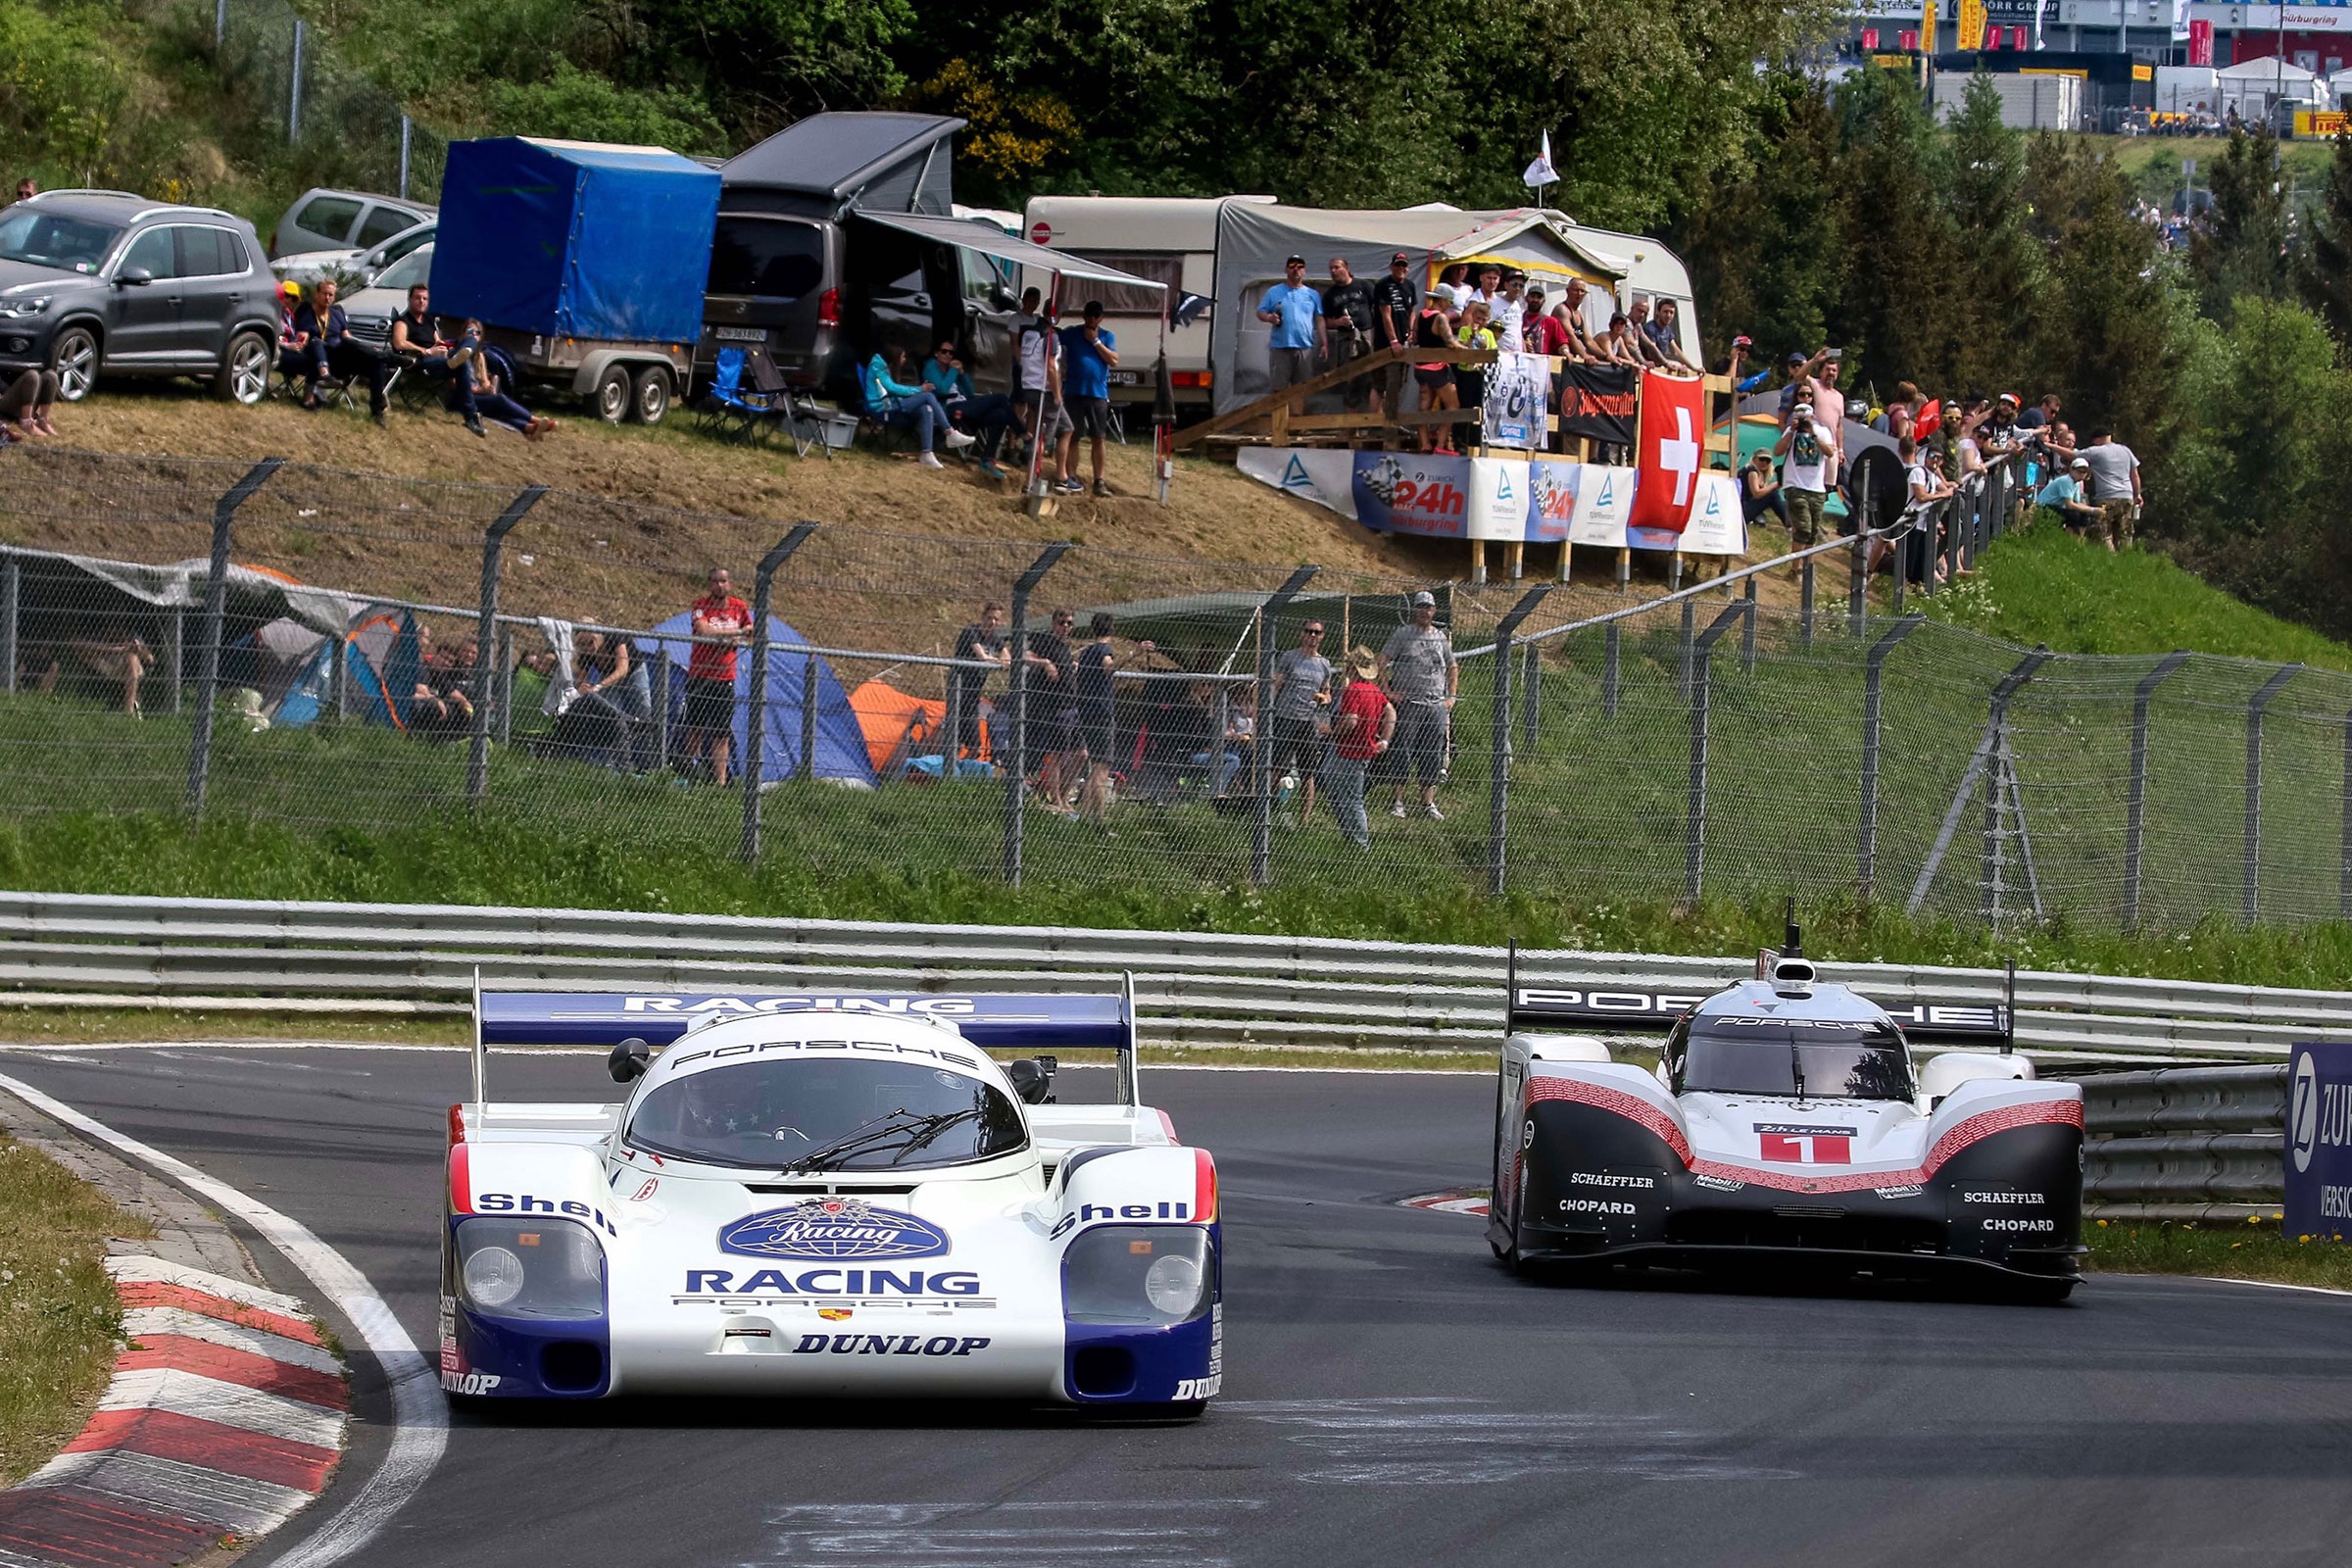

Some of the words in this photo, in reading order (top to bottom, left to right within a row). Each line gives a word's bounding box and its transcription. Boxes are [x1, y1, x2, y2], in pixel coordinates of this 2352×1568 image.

[1394, 480, 1464, 515] 24h
[623, 996, 975, 1014] RACING
[1714, 1016, 1882, 1034] PORSCHE
[670, 1039, 979, 1070] PORSCHE
[1783, 1137, 1814, 1163] 1
[1571, 1172, 1654, 1189] SCHAEFFLER
[1559, 1200, 1636, 1215] CHOPARD
[1964, 1192, 2045, 1204] SCHAEFFLER
[479, 1193, 617, 1239] Shell
[1050, 1201, 1188, 1242] Shell
[1983, 1218, 2054, 1232] CHOPARD
[768, 1221, 901, 1244] Racing
[685, 1269, 981, 1296] RACING
[792, 1333, 992, 1356] DUNLOP
[440, 1370, 501, 1396] DUNLOP
